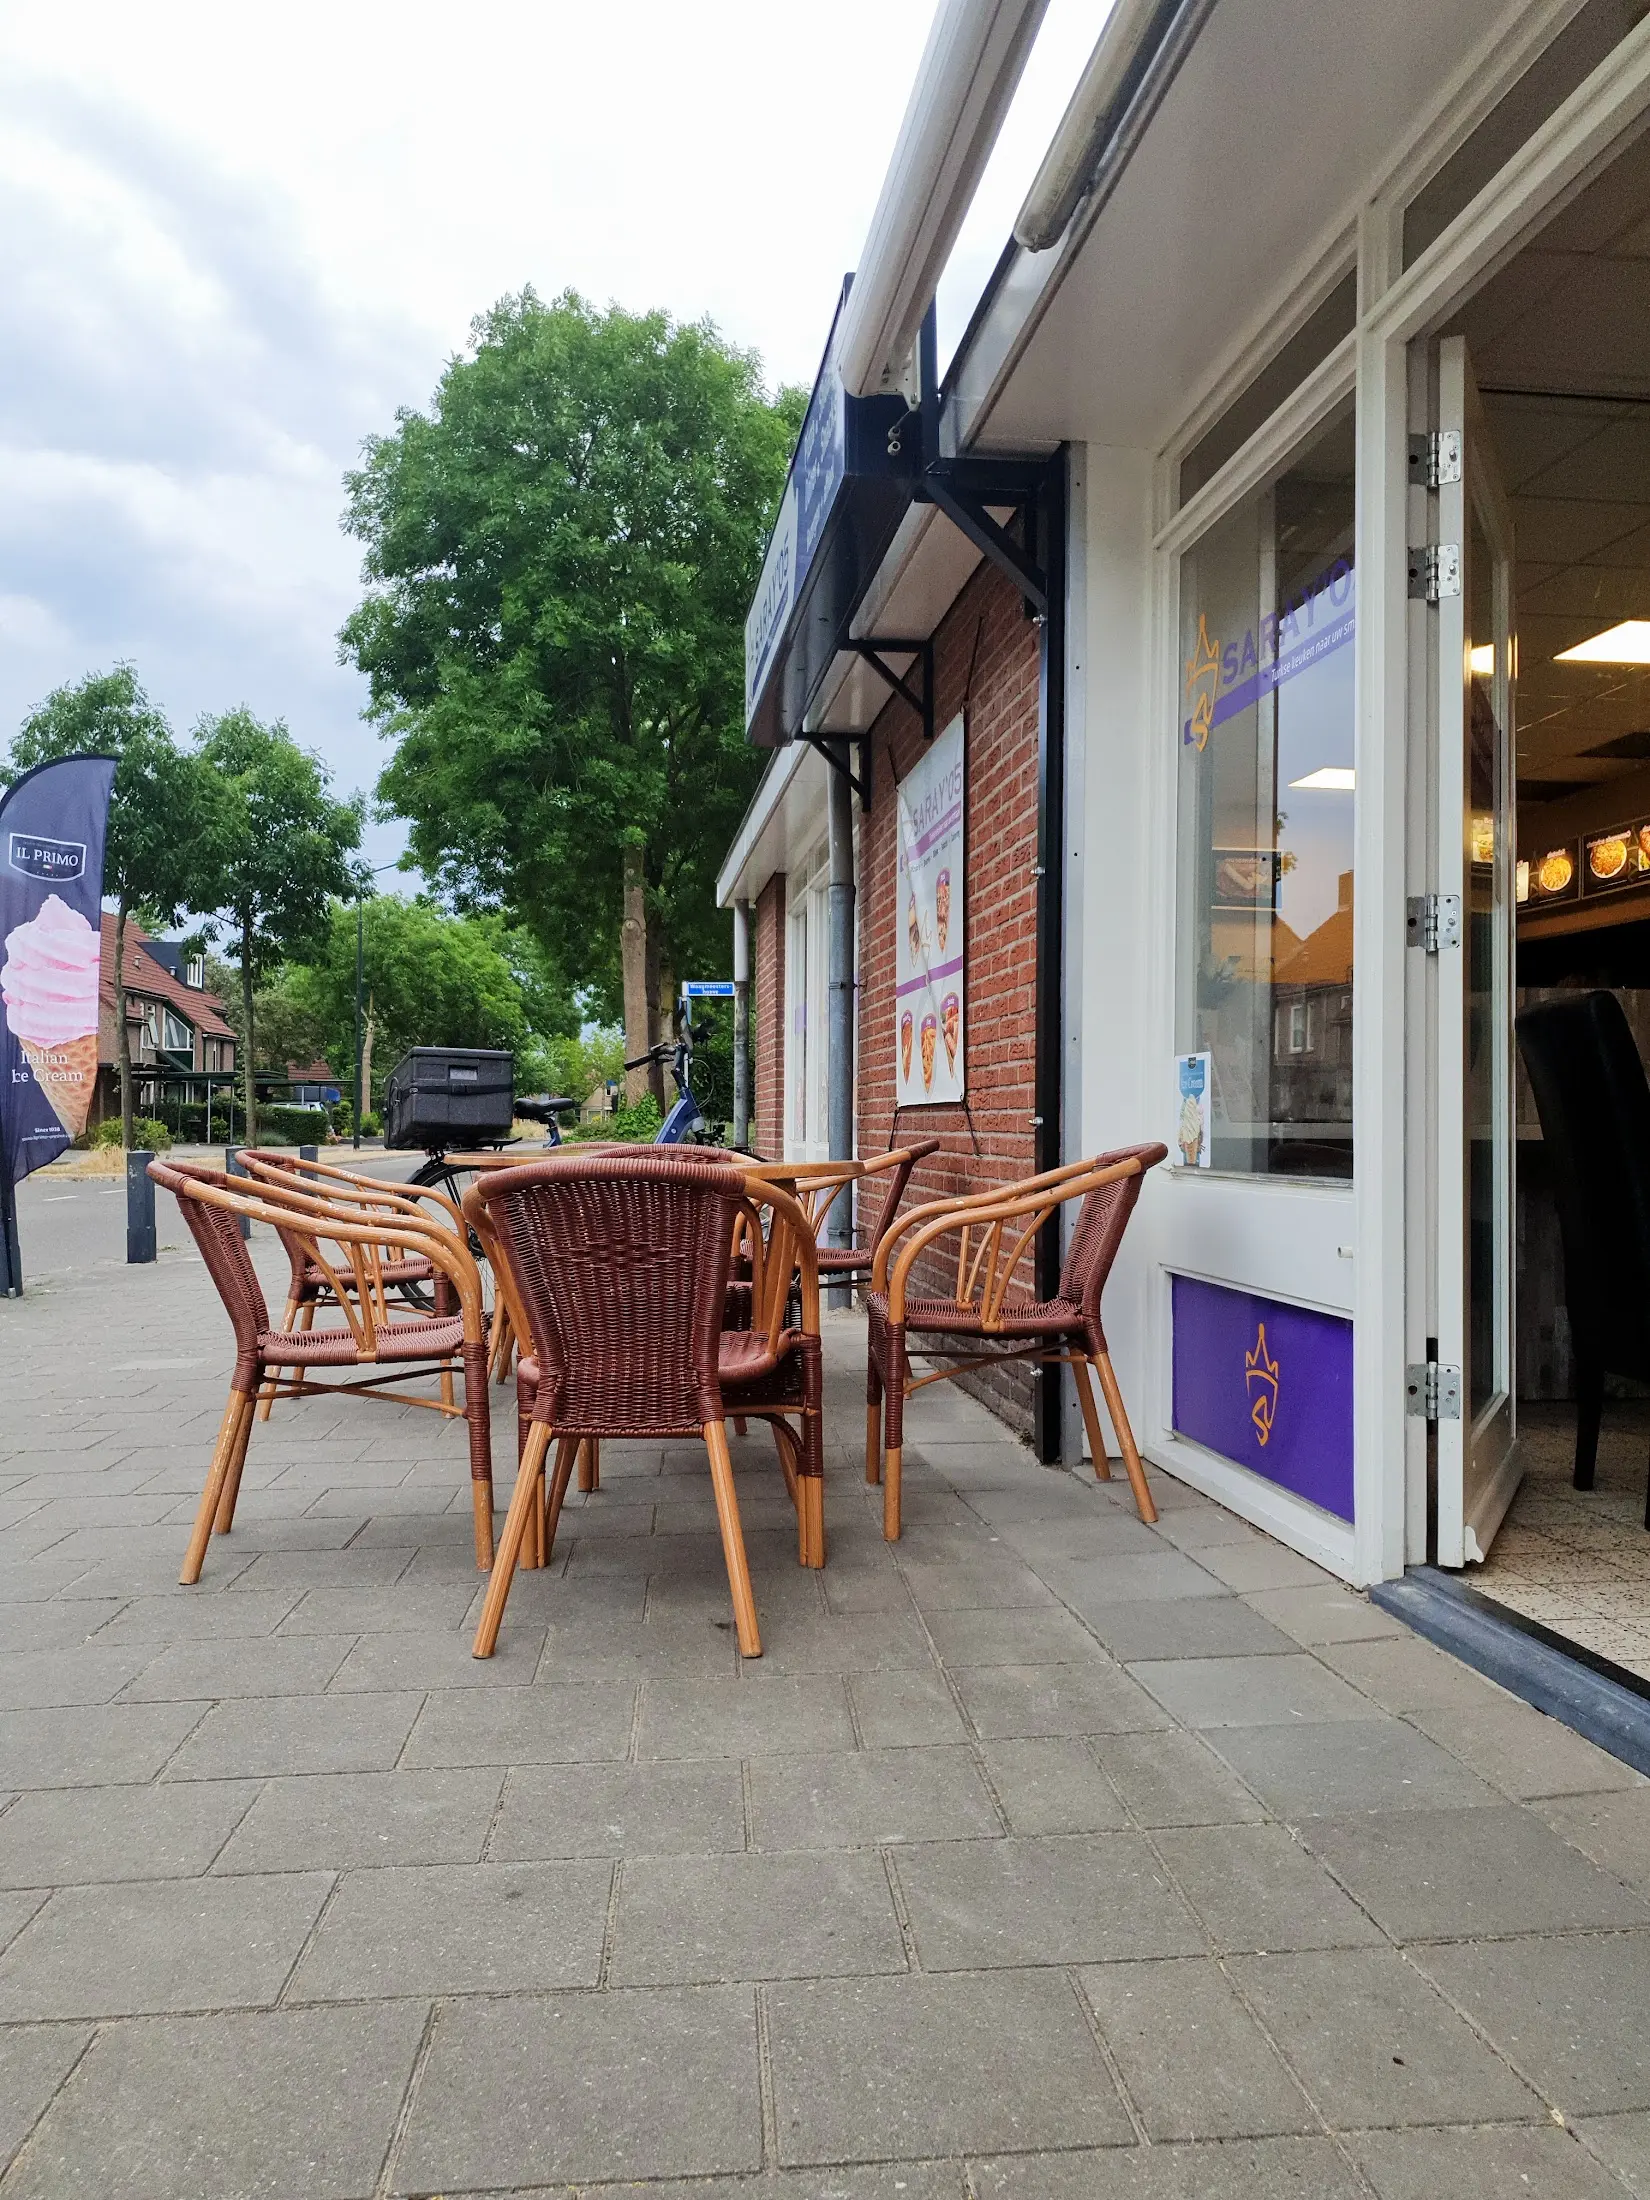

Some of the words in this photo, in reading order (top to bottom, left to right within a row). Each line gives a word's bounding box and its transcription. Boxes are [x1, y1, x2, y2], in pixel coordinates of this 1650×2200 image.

[1271, 661, 1290, 683] Turkse
[1291, 645, 1315, 670] keuken
[1315, 635, 1331, 654] naar
[1331, 627, 1343, 643] uw
[913, 761, 962, 837] SARAY'05
[16, 846, 31, 860] IL
[33, 849, 79, 867] PRIMO
[21, 1050, 69, 1065] Italian
[33, 1068, 84, 1083] Cream
